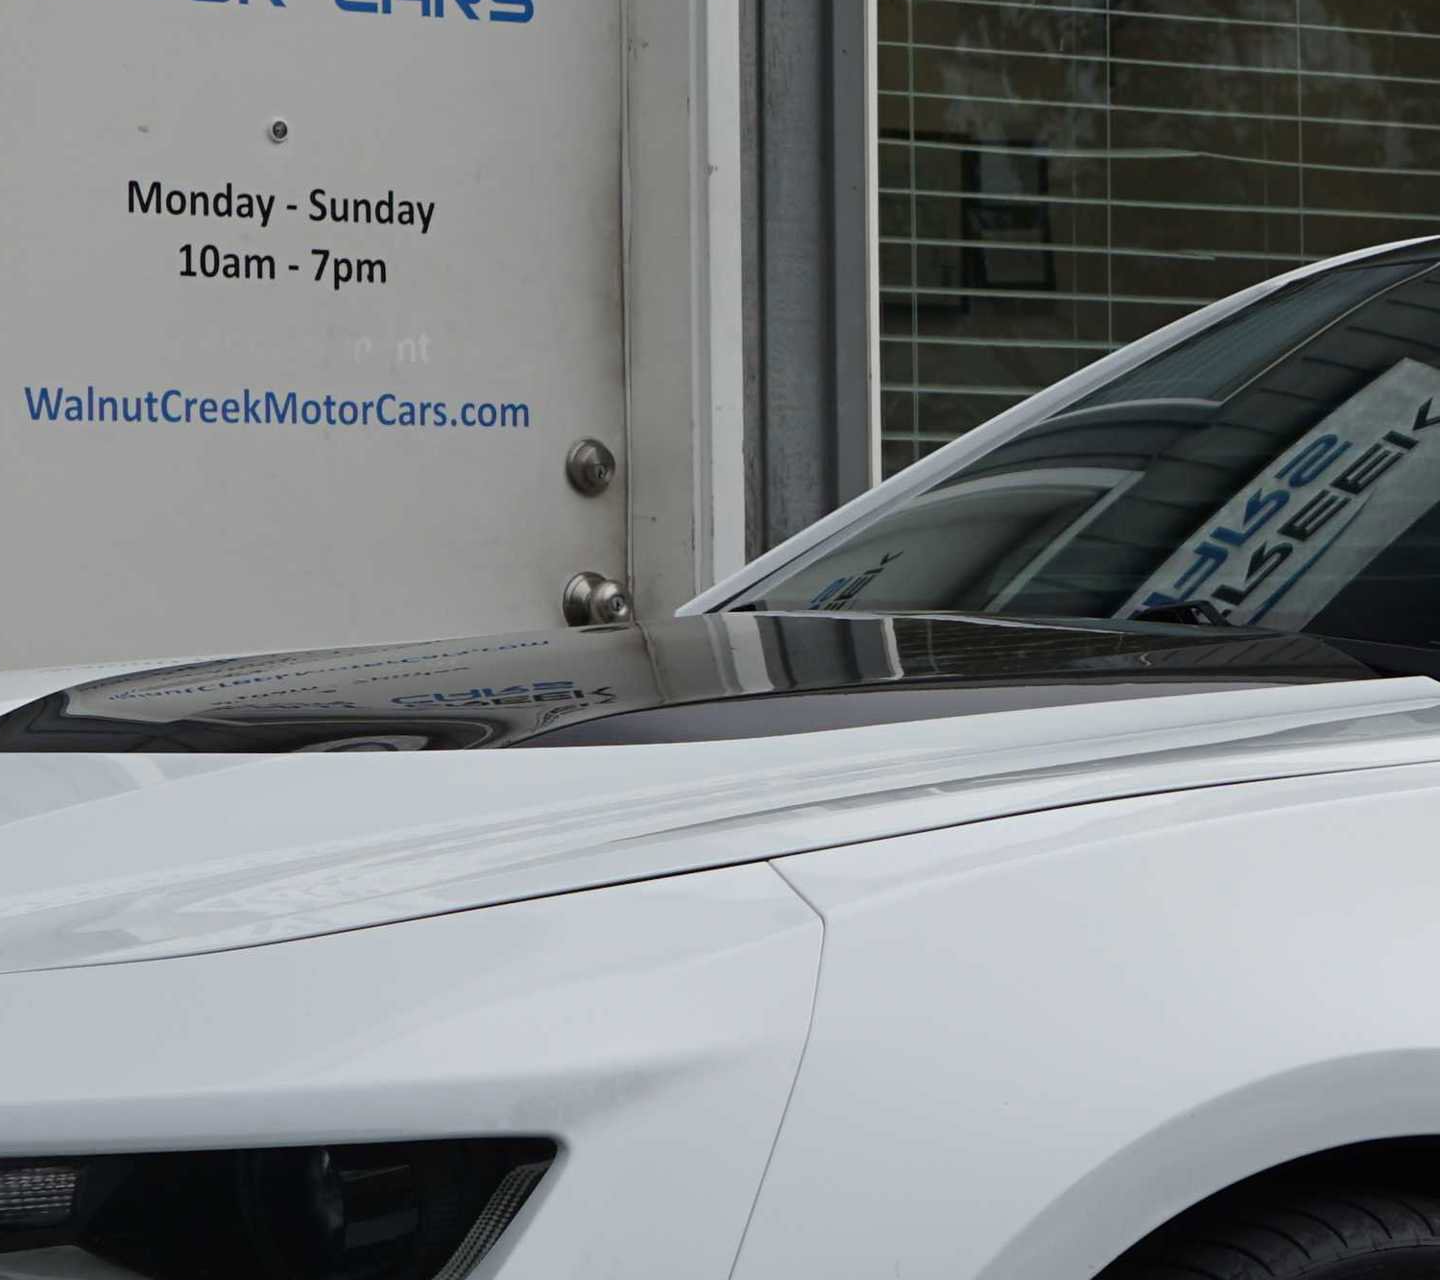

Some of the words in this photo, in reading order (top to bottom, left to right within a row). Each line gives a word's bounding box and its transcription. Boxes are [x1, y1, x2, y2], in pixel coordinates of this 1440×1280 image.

[128, 181, 275, 227] Monday
[309, 188, 436, 234] Sunday
[179, 243, 276, 280] 10am
[310, 248, 387, 290] 7pm
[24, 385, 530, 428] WalnutCreekMotorCars.com
